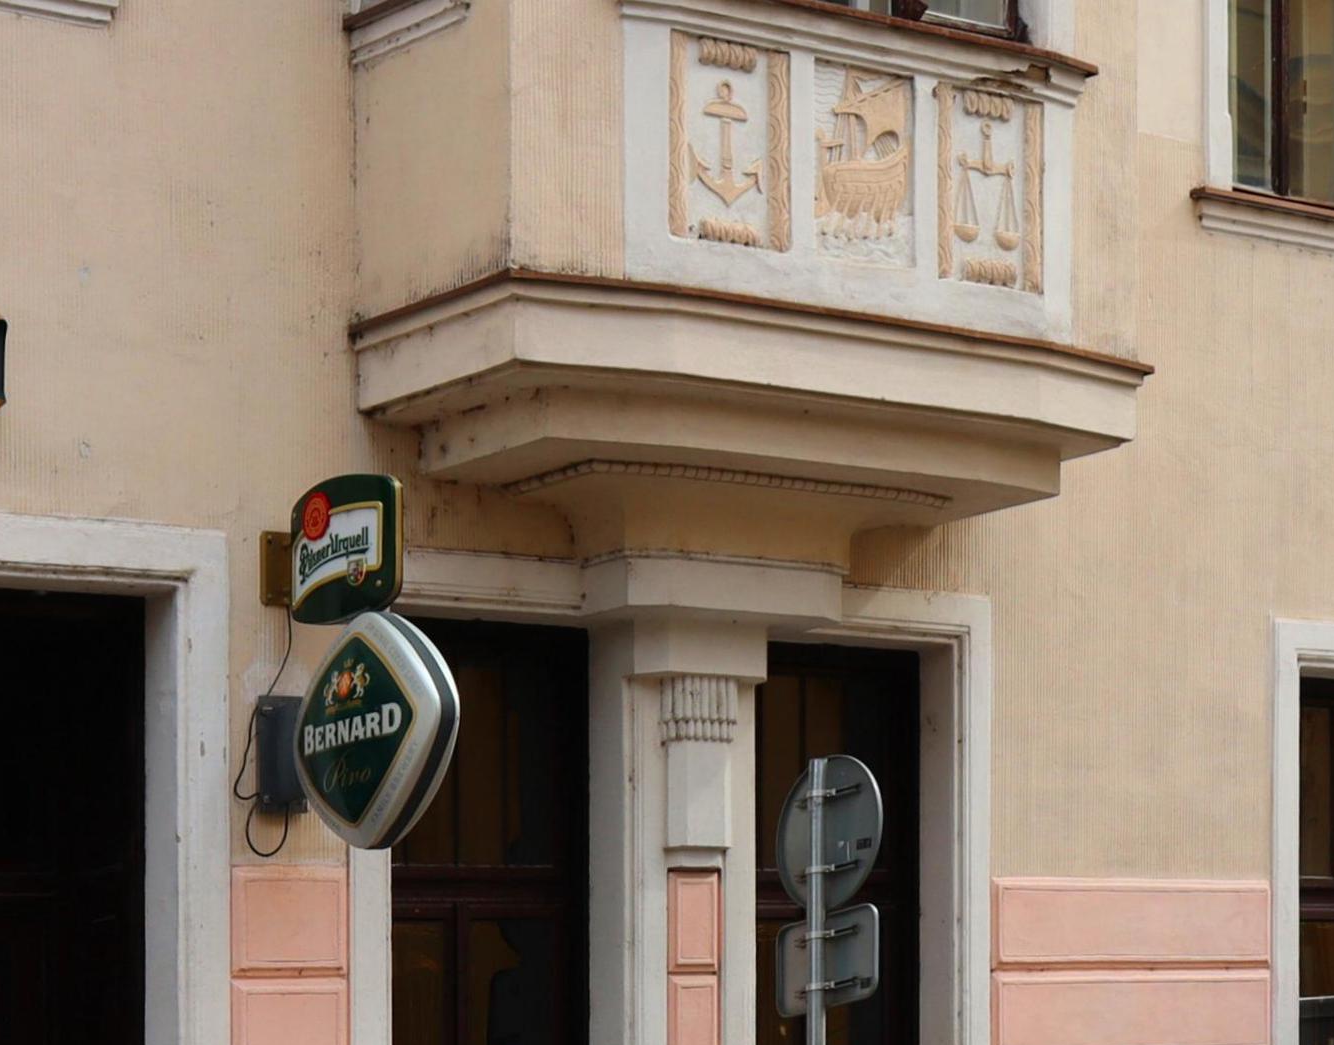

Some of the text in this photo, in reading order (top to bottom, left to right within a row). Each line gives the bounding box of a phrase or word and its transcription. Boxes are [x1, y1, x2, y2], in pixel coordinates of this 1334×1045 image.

[298, 526, 369, 584] Pilsner Urquell
[303, 702, 402, 756] BERNARD
